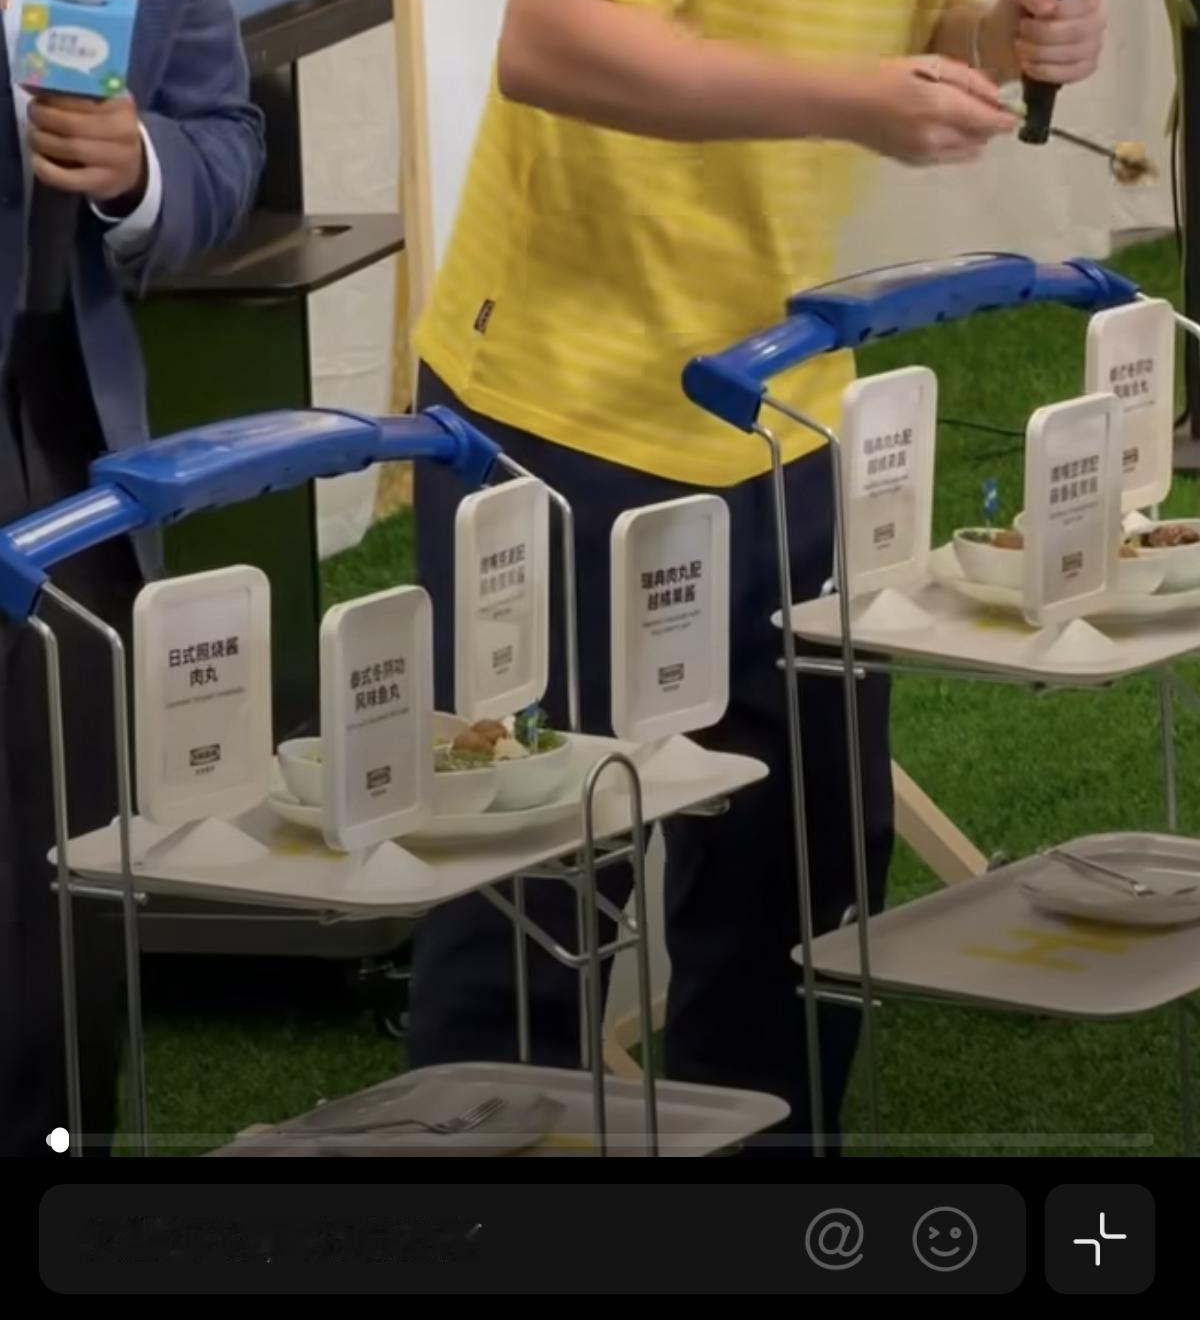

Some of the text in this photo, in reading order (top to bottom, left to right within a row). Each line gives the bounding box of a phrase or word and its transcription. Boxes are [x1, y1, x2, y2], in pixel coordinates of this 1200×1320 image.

[168, 635, 239, 668] 日式照烧酱
[190, 664, 219, 688] 肉丸
[355, 683, 401, 712] 风味鱼丸
